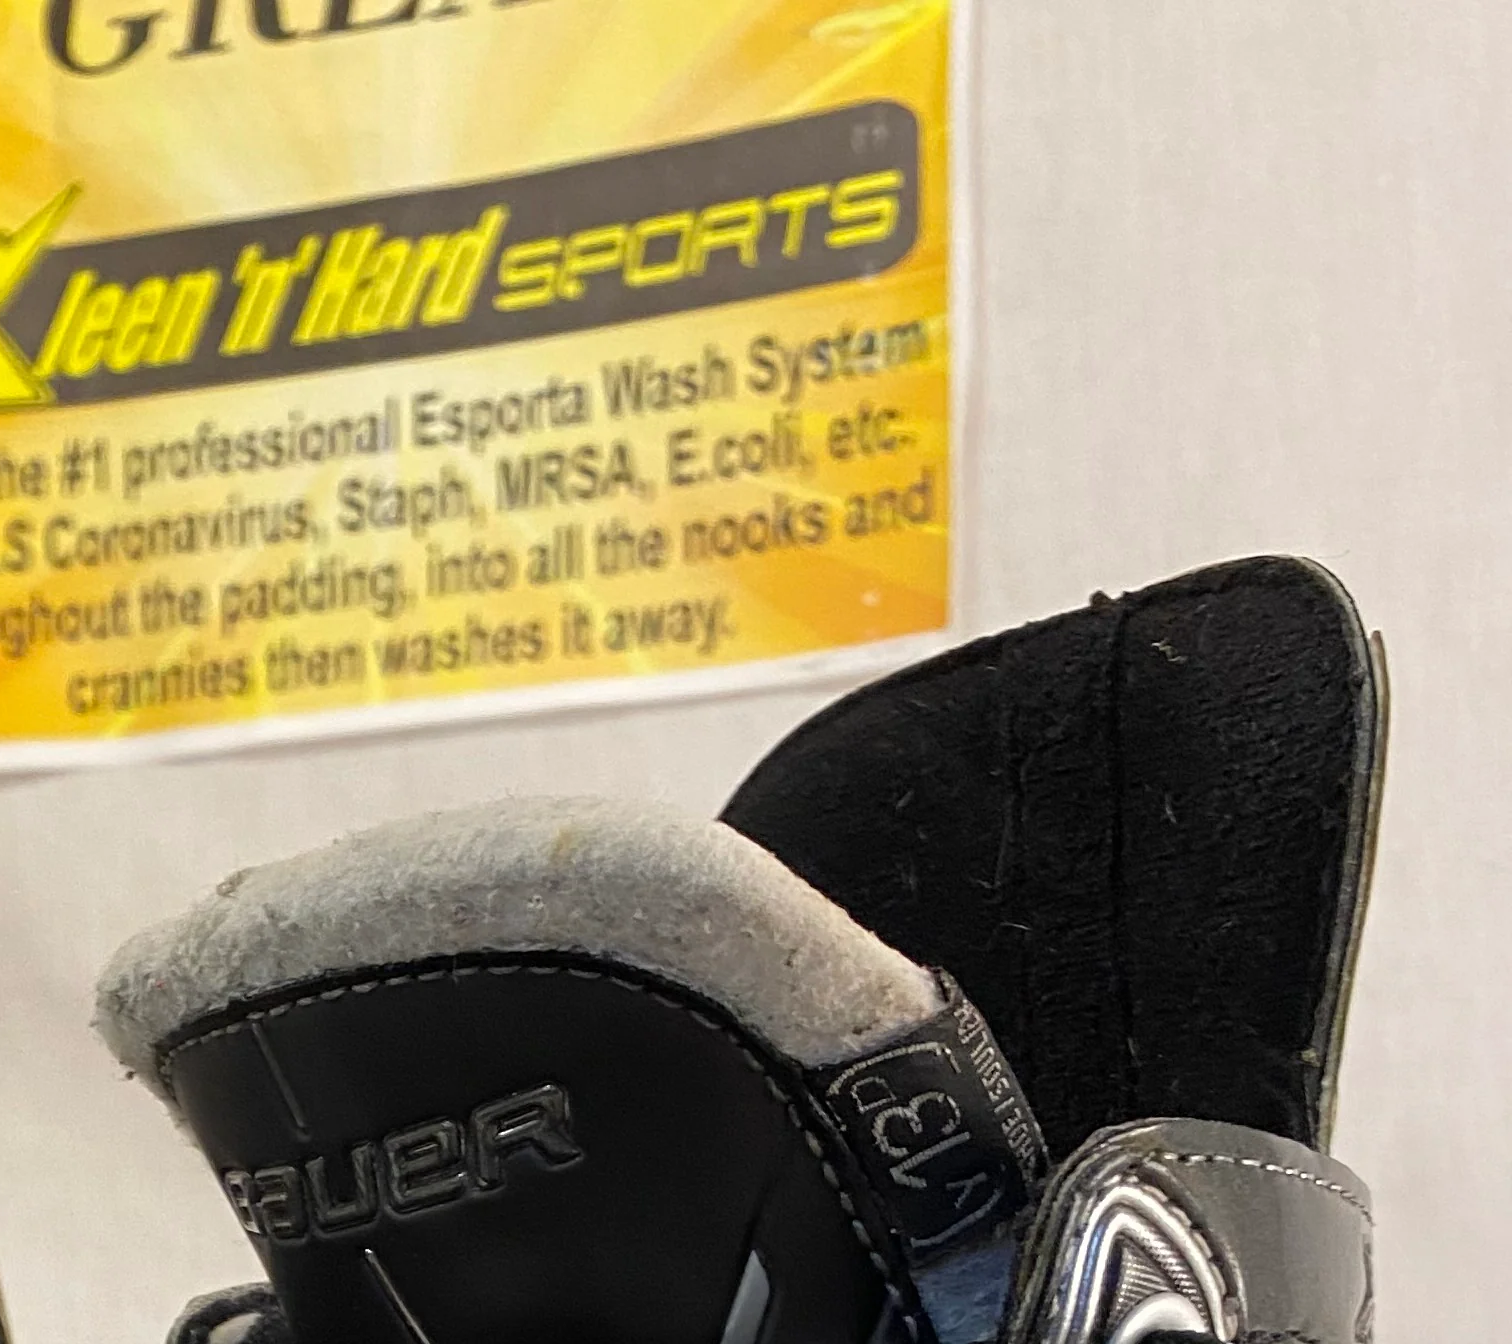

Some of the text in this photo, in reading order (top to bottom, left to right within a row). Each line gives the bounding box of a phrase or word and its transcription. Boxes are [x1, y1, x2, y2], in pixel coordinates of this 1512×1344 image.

[291, 201, 508, 347] Hard
[492, 169, 904, 313] SPORTS
[58, 437, 110, 495] #1
[122, 395, 400, 500] professional
[411, 374, 586, 452] Esporta
[601, 343, 735, 418] Wash
[746, 318, 927, 401] System
[337, 464, 485, 534] Staph,
[495, 442, 649, 511] MRSA,
[826, 403, 915, 459] etc.
[138, 575, 204, 630] the
[218, 556, 412, 638] padding,
[426, 541, 516, 597] into
[525, 522, 586, 583] all
[595, 517, 668, 575] the
[680, 493, 828, 561] nooks
[843, 466, 936, 537] and
[65, 597, 738, 716] crannies then washes it away.
